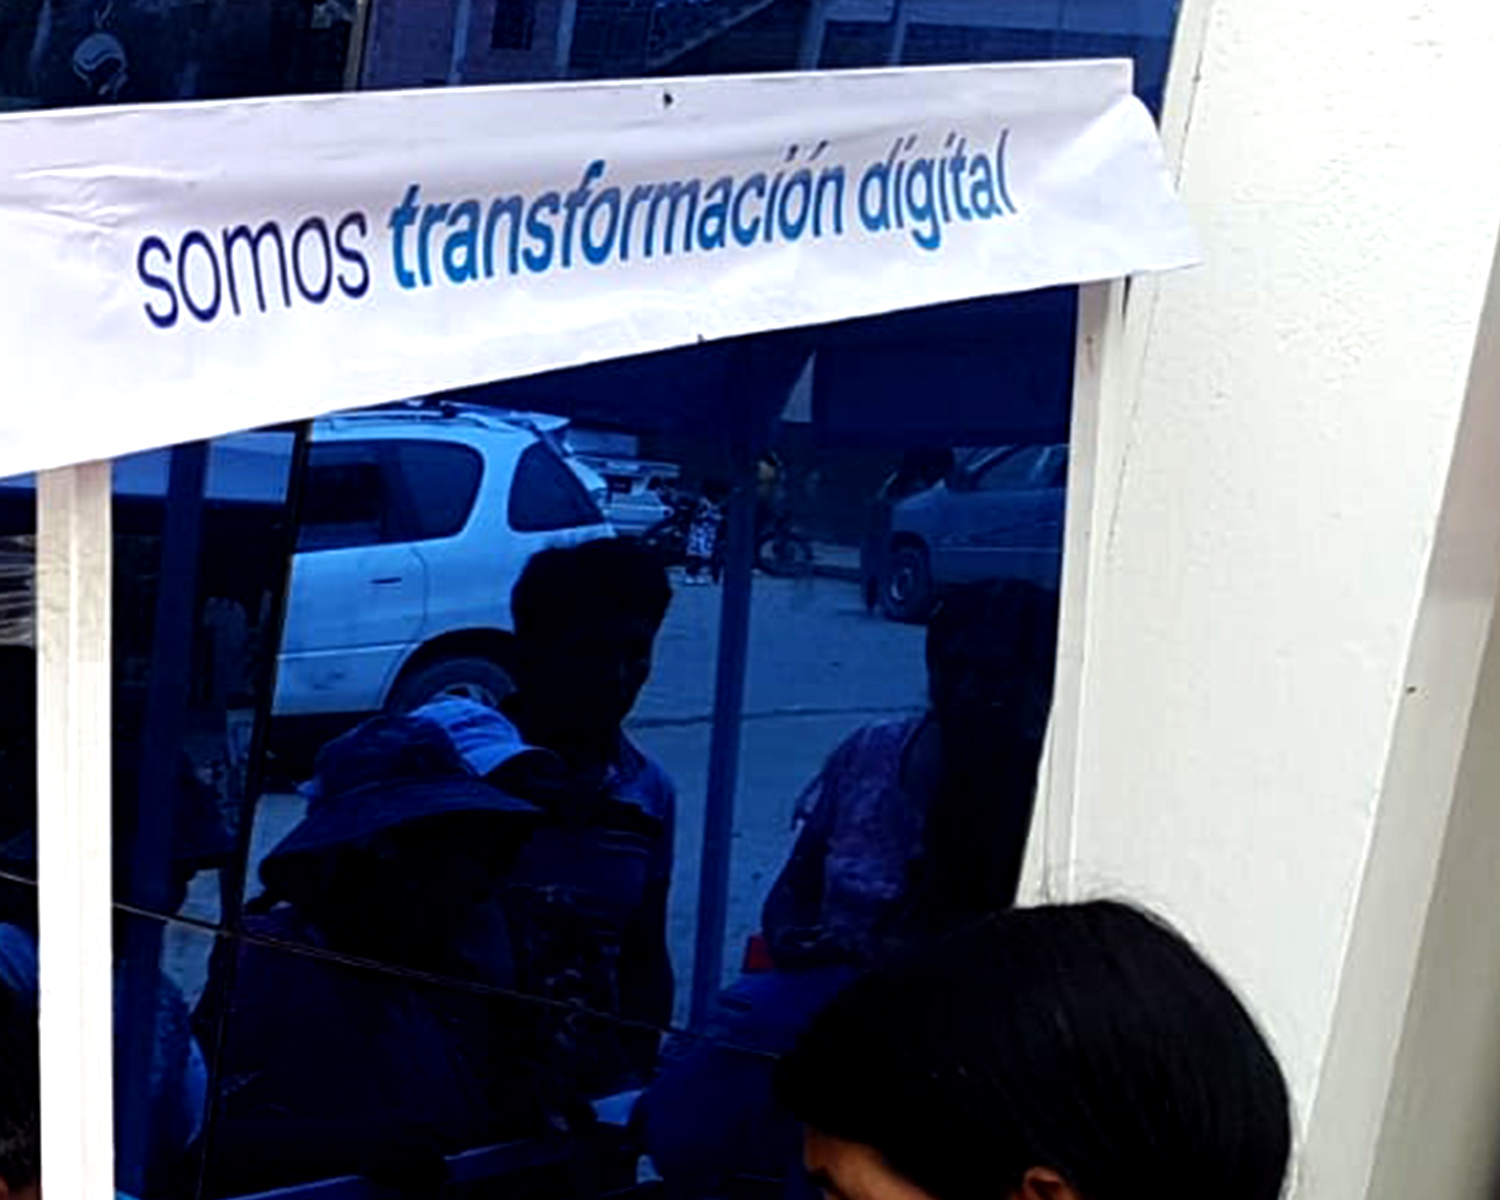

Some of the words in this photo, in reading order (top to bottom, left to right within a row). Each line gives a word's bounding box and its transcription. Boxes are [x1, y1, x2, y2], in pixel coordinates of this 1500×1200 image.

[138, 211, 371, 330] somos
[389, 139, 844, 289] transformación
[857, 128, 1016, 250] digital
